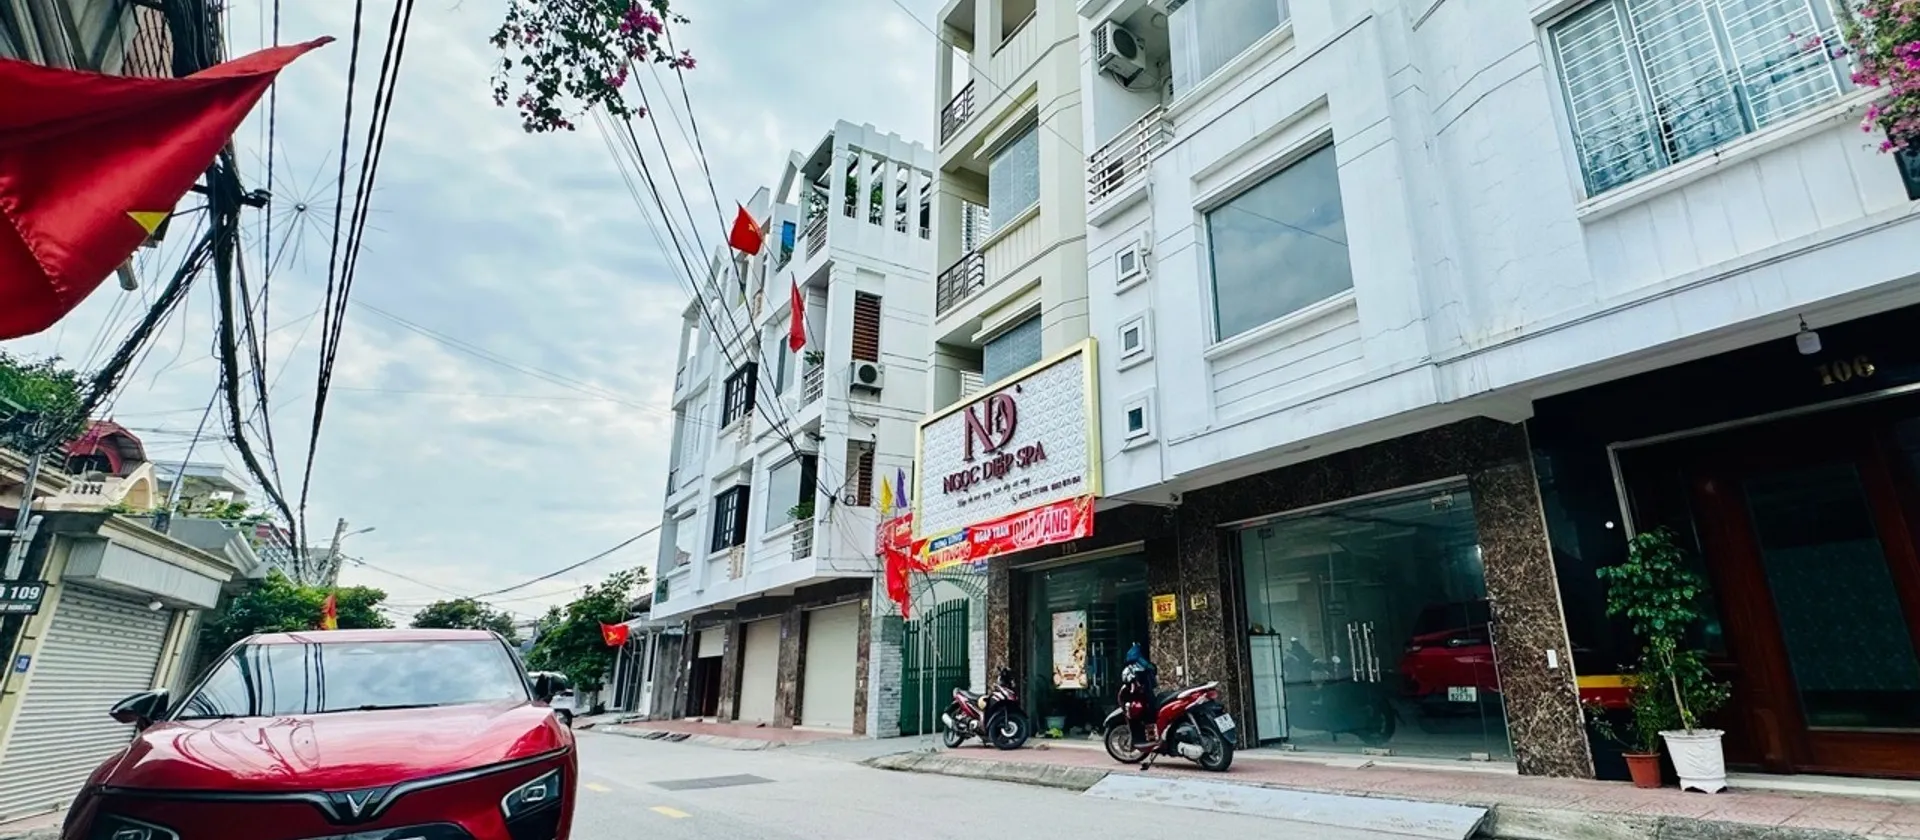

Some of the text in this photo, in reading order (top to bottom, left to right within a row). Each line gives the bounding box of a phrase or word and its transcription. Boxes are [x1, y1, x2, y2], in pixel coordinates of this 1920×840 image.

[1816, 356, 1875, 386] 106
[943, 465, 980, 494] NGỌC
[982, 451, 1014, 480] DIỆP
[1016, 441, 1047, 468] SPA
[11, 586, 40, 600] 109
